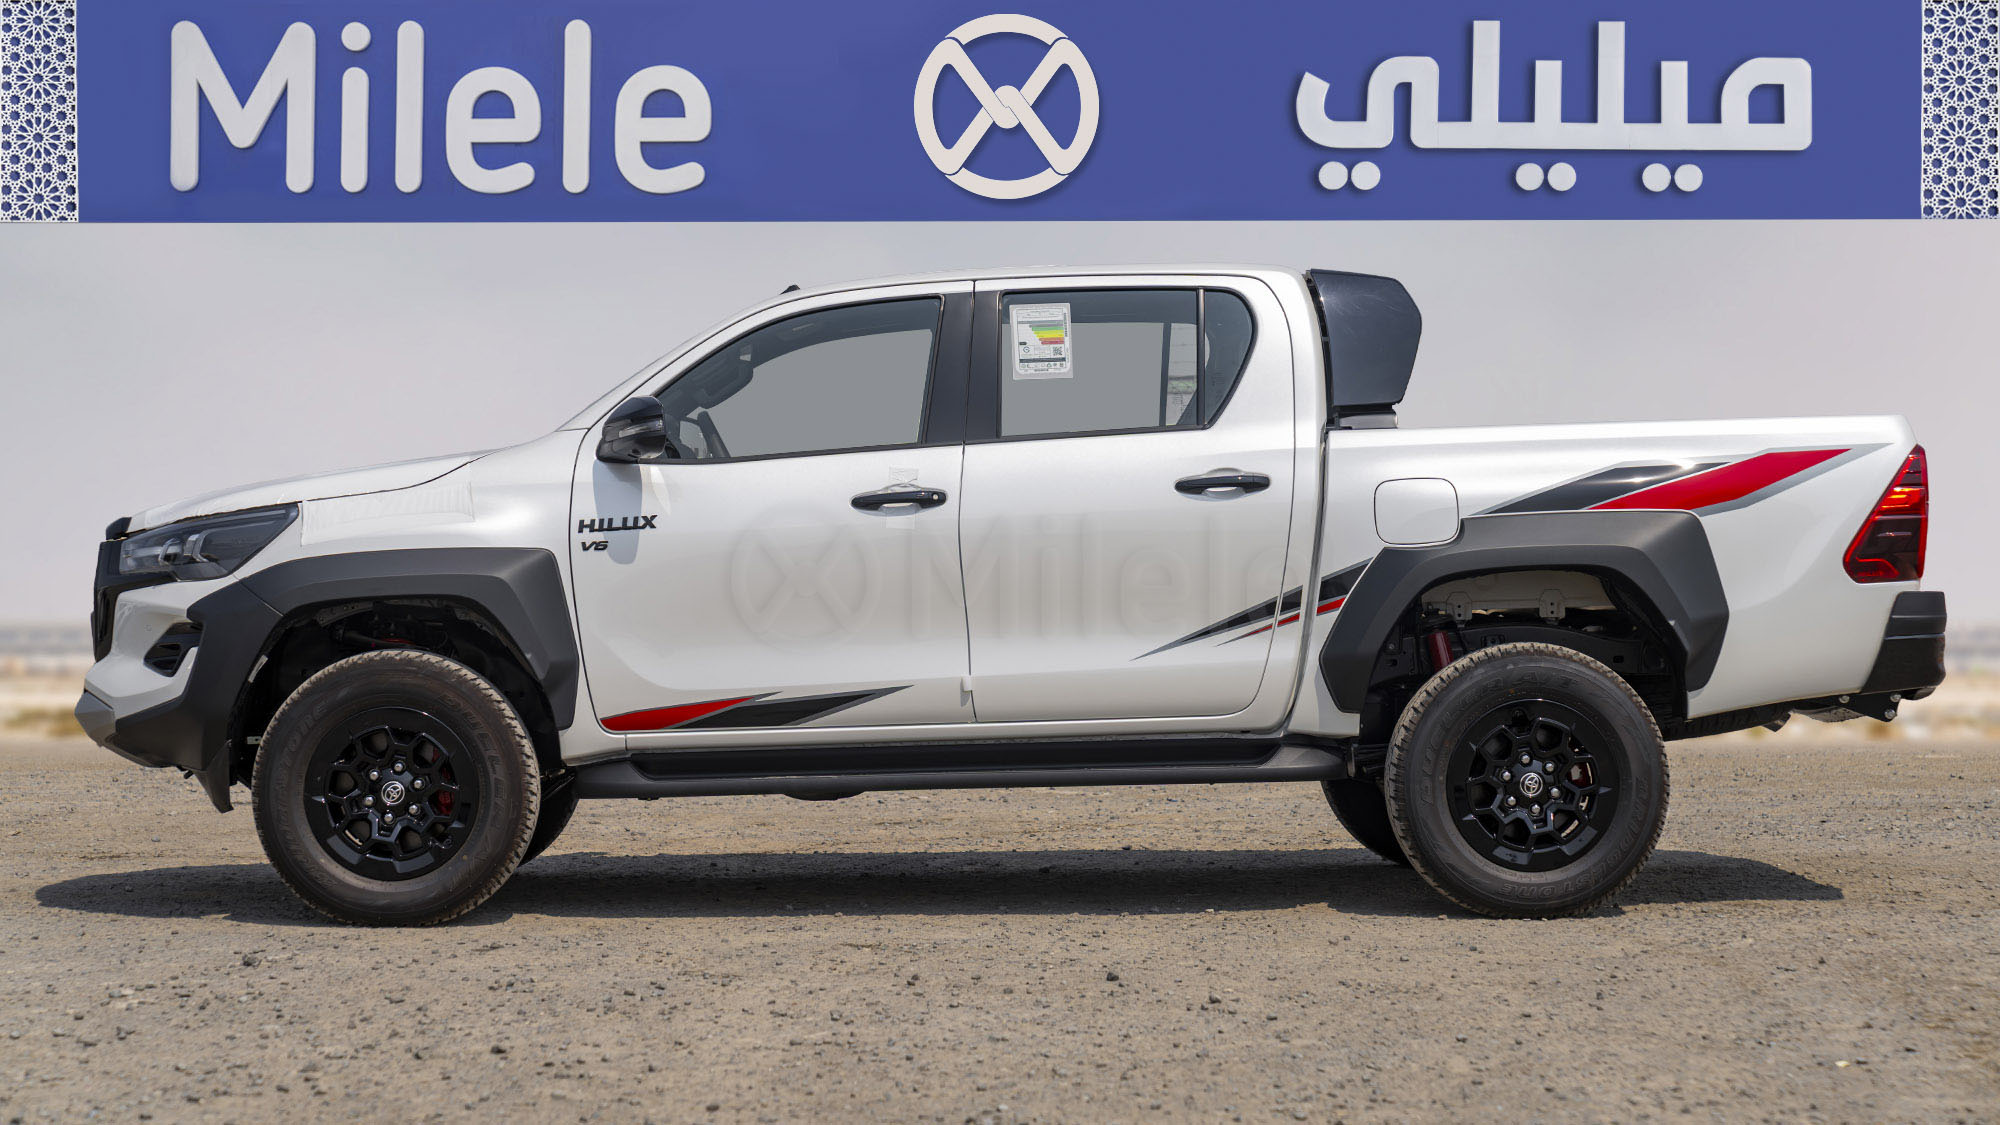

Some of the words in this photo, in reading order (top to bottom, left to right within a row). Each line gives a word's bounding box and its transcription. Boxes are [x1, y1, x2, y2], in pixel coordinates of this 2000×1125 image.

[170, 19, 712, 194] Milele
[1296, 20, 1812, 192] ميليلي
[577, 514, 658, 534] HILUX
[580, 540, 608, 552] V6
